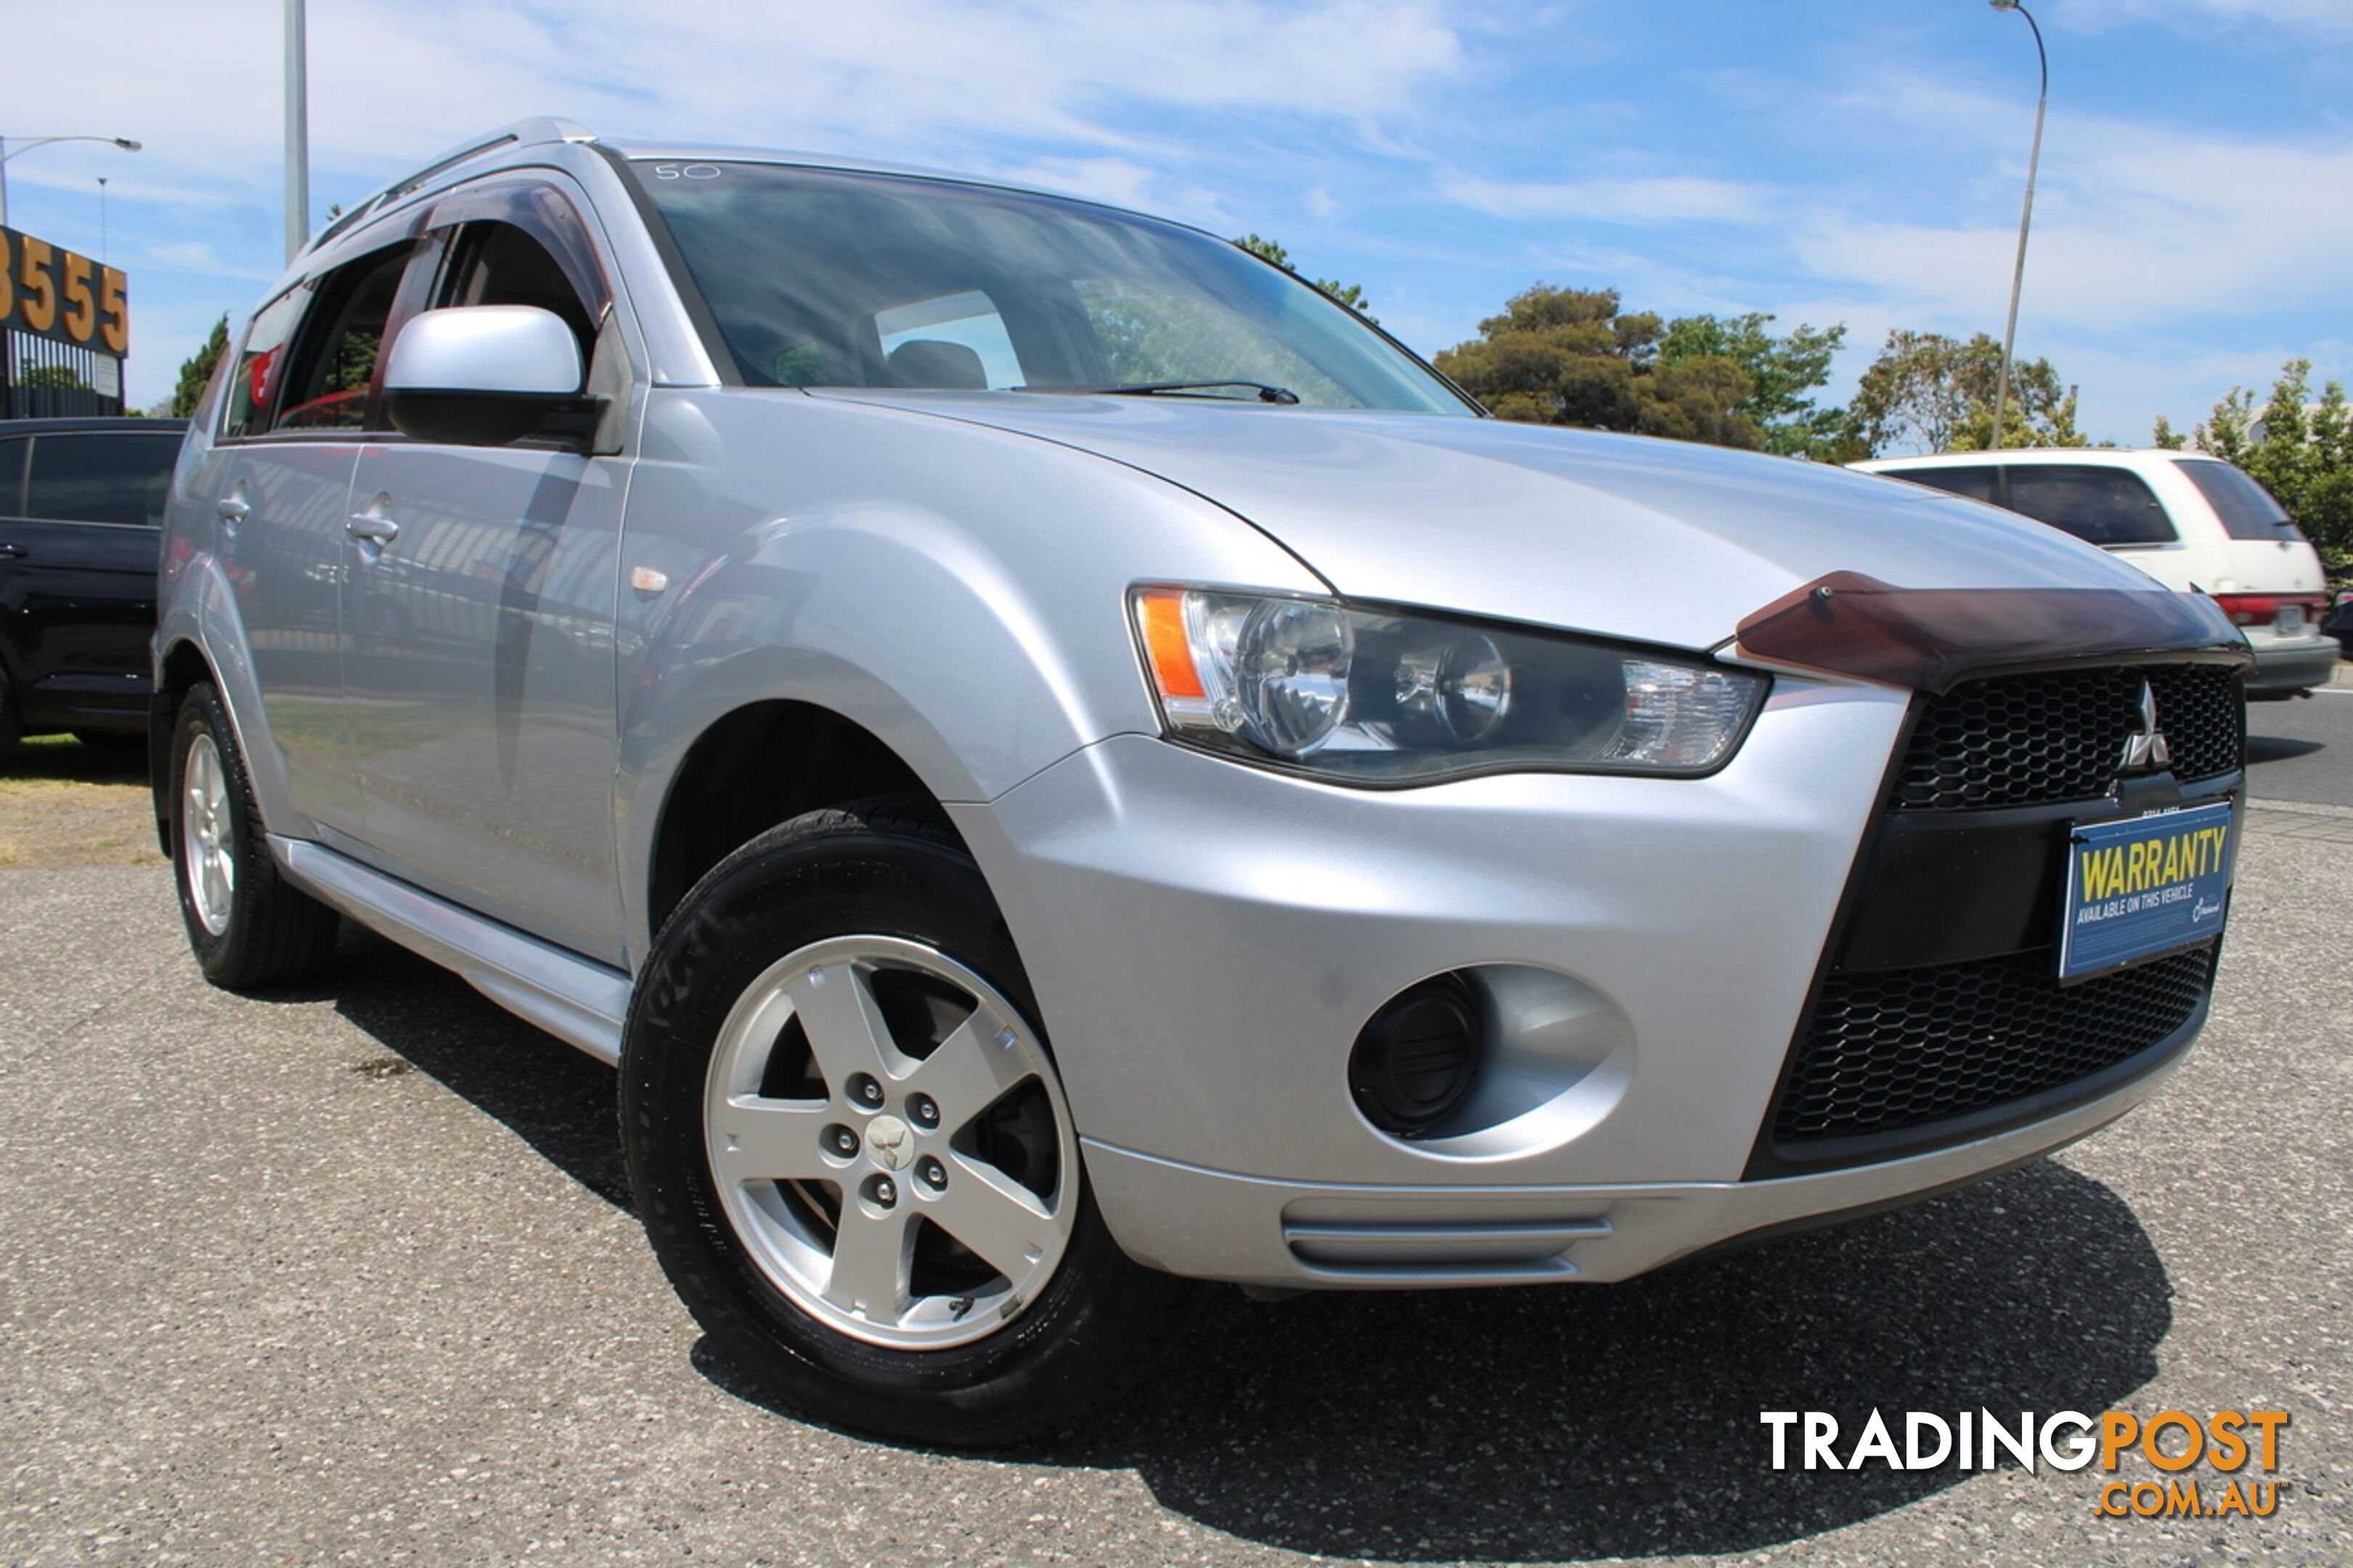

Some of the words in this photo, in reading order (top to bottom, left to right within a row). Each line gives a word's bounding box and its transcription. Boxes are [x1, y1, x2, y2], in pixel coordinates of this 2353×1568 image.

[655, 163, 722, 180] 50
[2082, 826, 2227, 902] WARRANTY
[2077, 899, 2126, 926] AVAILABLE
[2126, 894, 2140, 913] ON
[2141, 891, 2160, 910] THIS
[2161, 882, 2194, 905] VEHICLE
